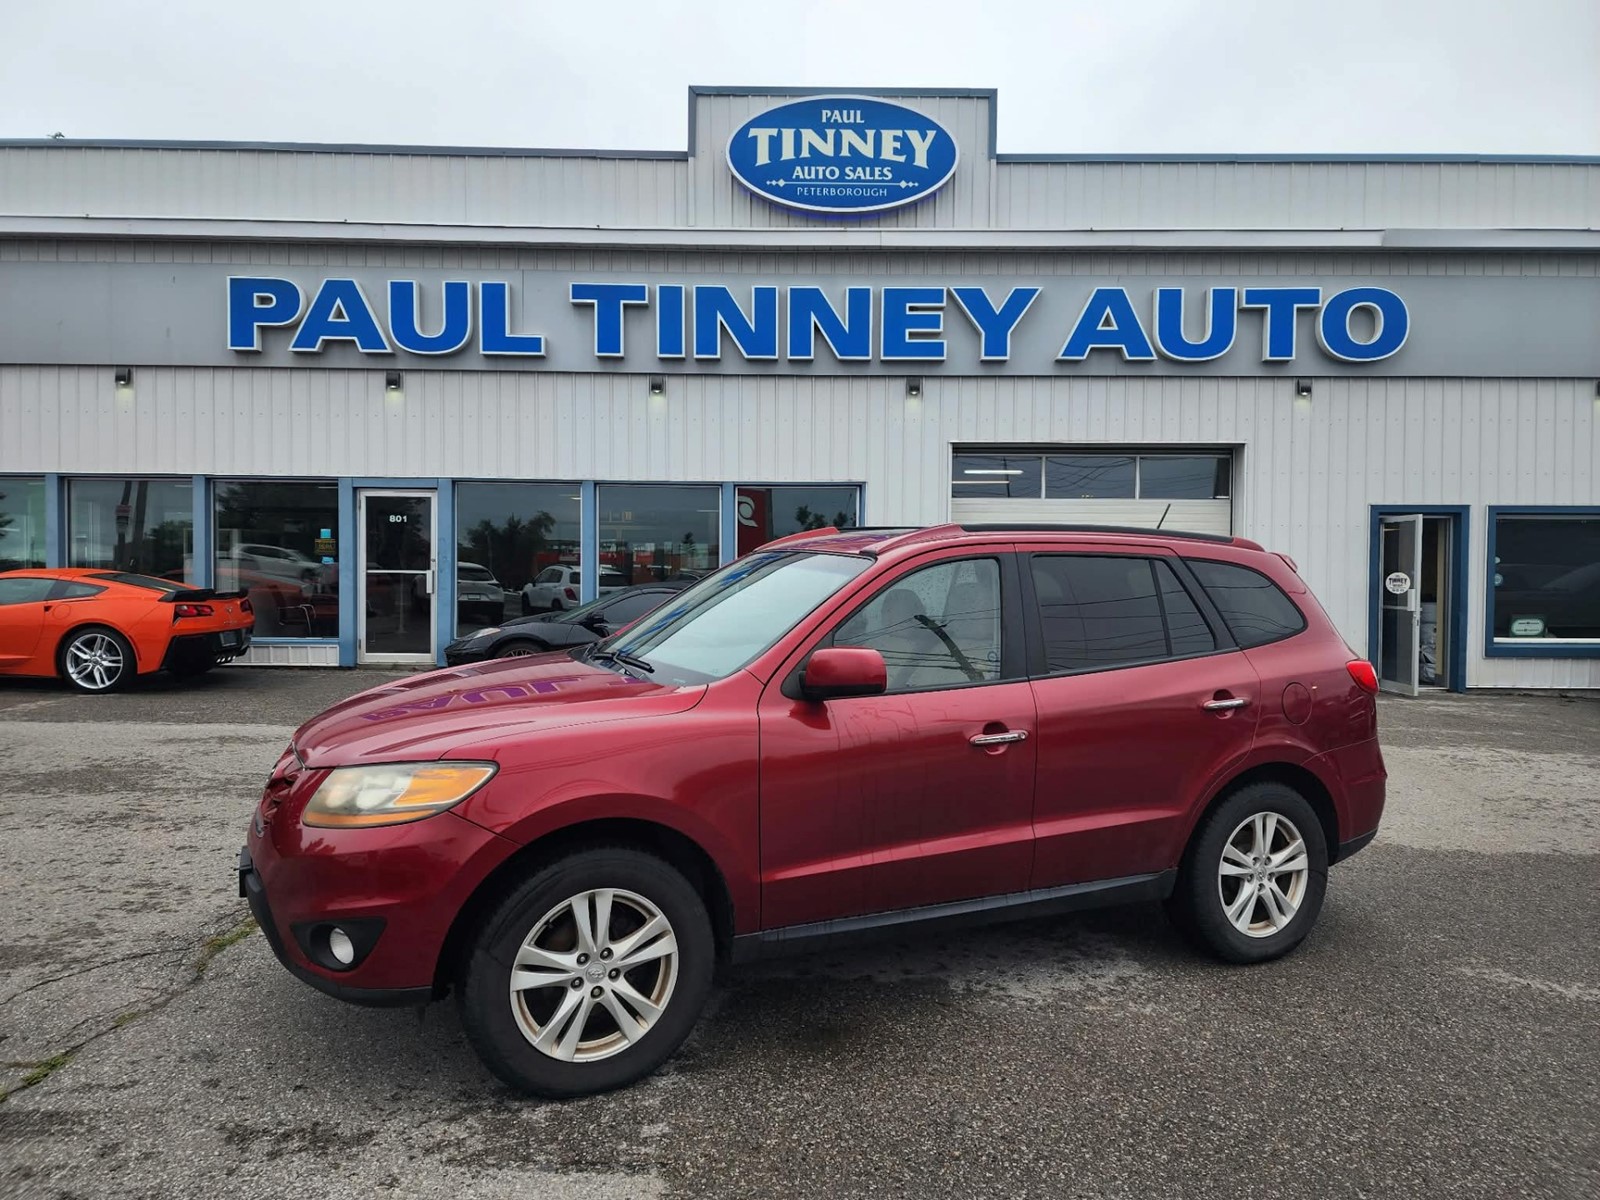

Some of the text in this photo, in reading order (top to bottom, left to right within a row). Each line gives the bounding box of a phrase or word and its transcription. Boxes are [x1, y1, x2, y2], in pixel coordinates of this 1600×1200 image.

[821, 109, 865, 124] PAUL
[748, 128, 937, 169] TINNEY
[792, 166, 893, 181] AUTO SALES
[797, 187, 888, 197] PETERBOROUGH
[227, 275, 1411, 363] PAUL TINNEY AUTO
[388, 514, 408, 523] 801
